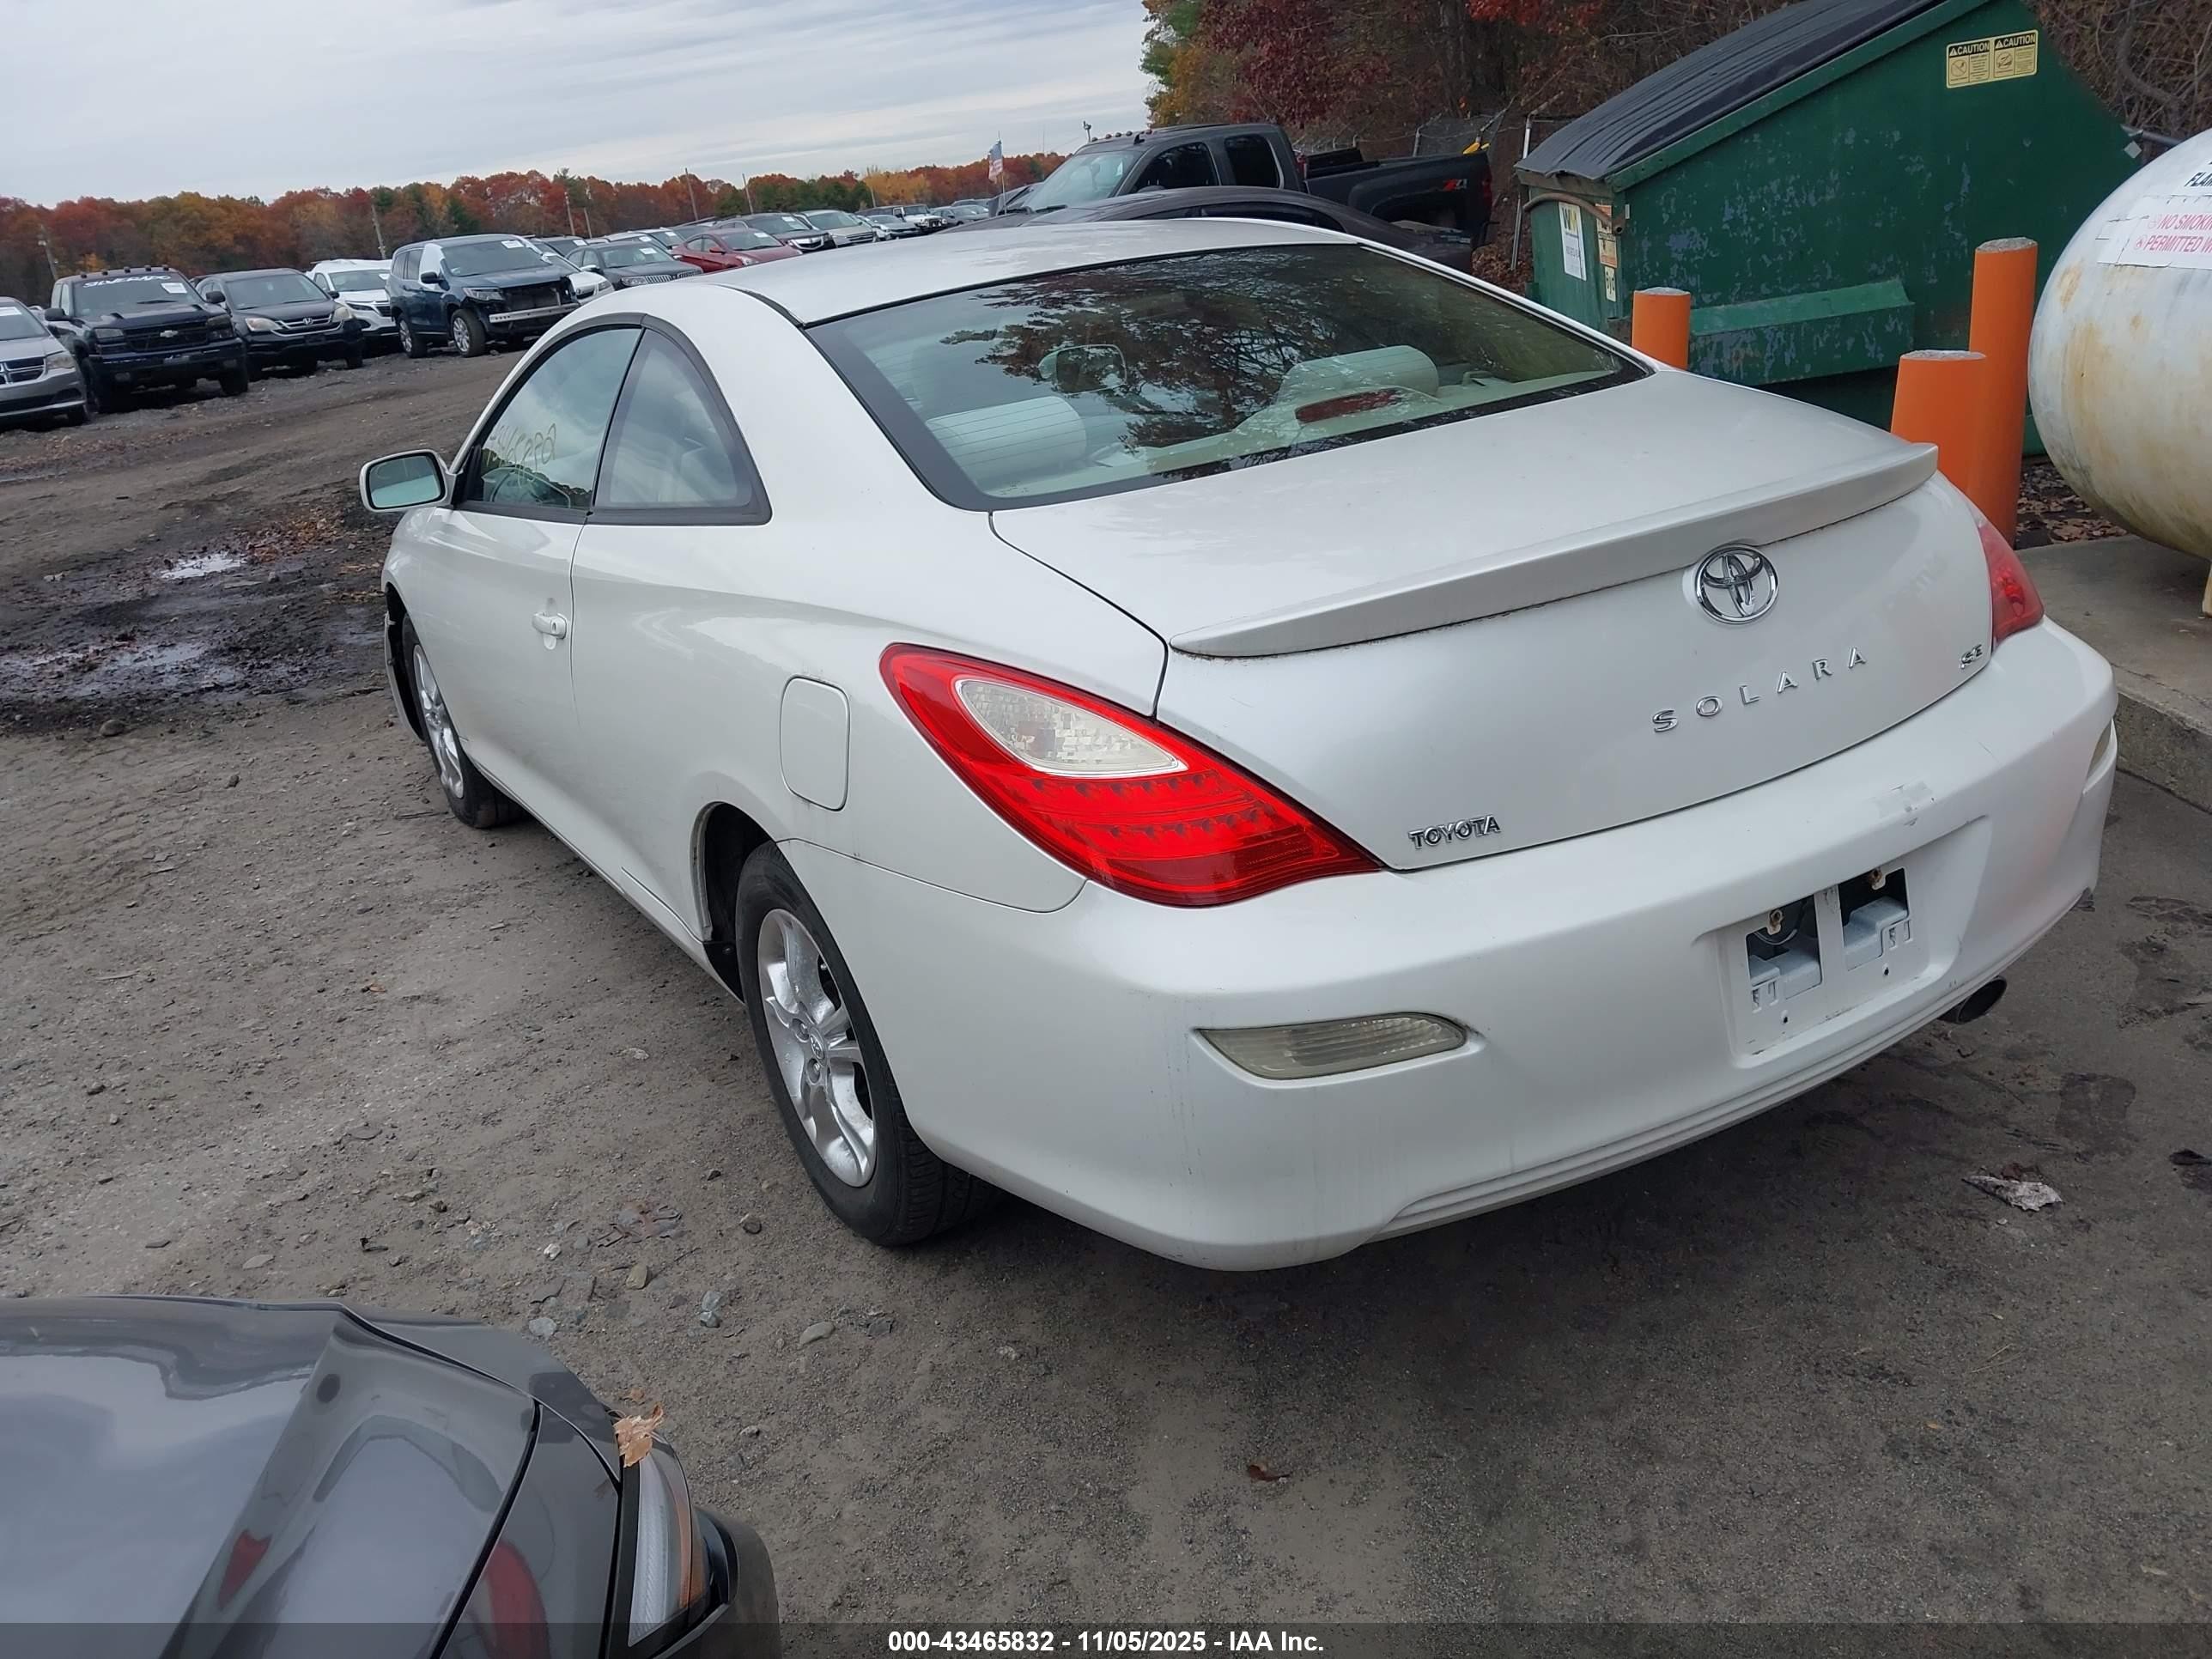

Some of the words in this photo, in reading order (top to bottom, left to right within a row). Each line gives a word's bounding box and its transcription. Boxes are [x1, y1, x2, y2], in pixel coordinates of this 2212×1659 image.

[1958, 41, 1990, 55] CAUTION
[2003, 34, 2035, 47] CAUTION
[2156, 214, 2179, 230] NO
[2143, 235, 2204, 252] PERMITTED
[1960, 644, 1983, 670] SE
[1651, 646, 1869, 733] SOLARA
[1408, 814, 1501, 849] TOYOTA
